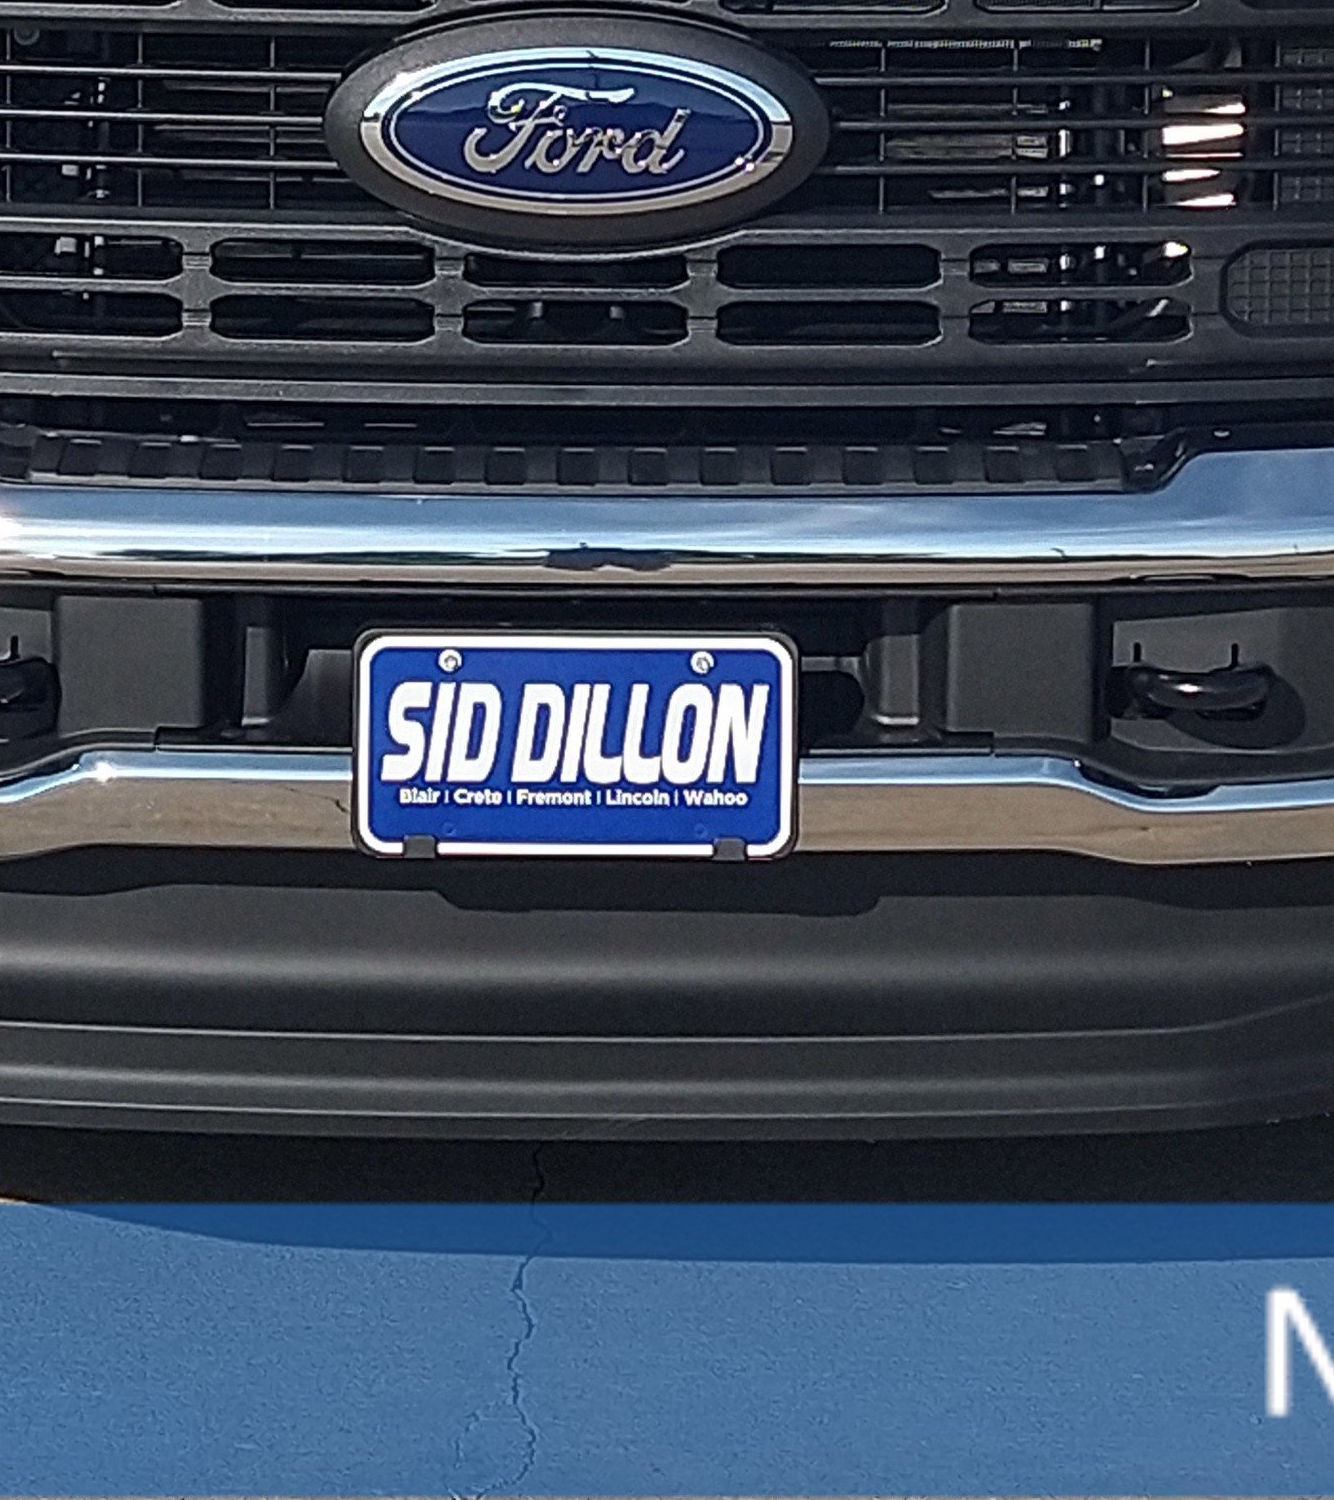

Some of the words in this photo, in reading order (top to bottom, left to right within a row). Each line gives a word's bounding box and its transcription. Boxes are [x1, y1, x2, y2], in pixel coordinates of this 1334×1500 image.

[466, 82, 691, 174] Ford
[380, 680, 503, 783] SID
[510, 681, 770, 785] DILLON
[399, 787, 441, 804] Blair
[453, 788, 503, 806] Crete
[517, 789, 593, 806] Fremont
[605, 788, 670, 806] Lincoln
[683, 788, 748, 806] Wahoo
